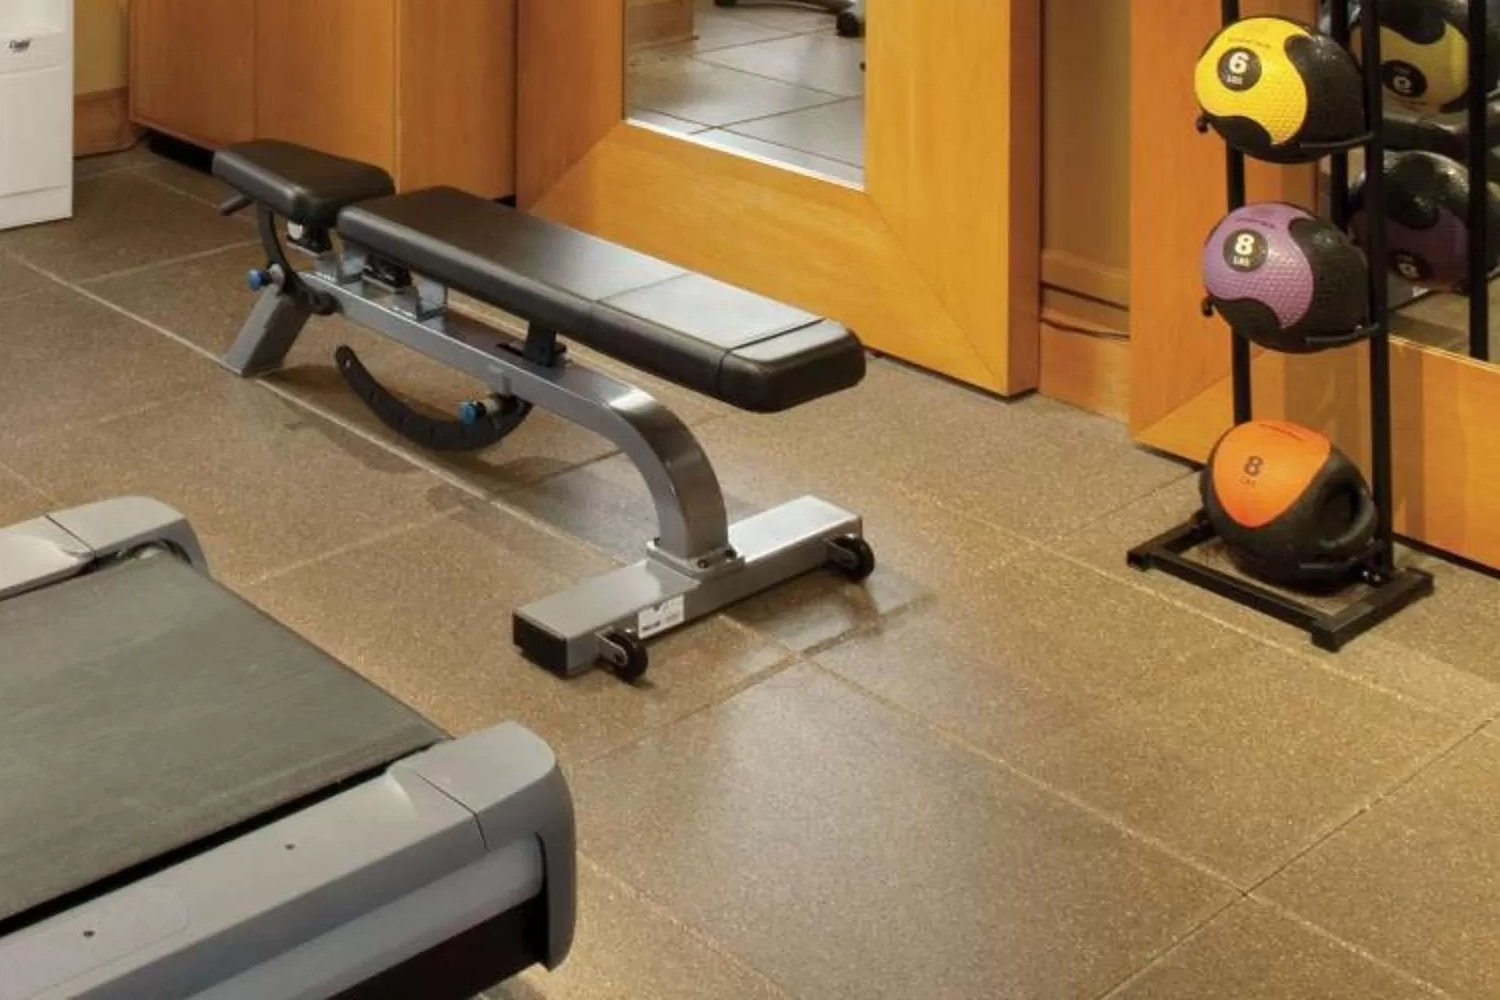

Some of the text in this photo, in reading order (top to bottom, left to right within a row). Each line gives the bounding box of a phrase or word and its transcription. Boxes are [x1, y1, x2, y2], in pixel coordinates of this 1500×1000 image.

[1228, 51, 1250, 75] 6
[1234, 233, 1256, 256] 8
[1243, 455, 1264, 477] 8
